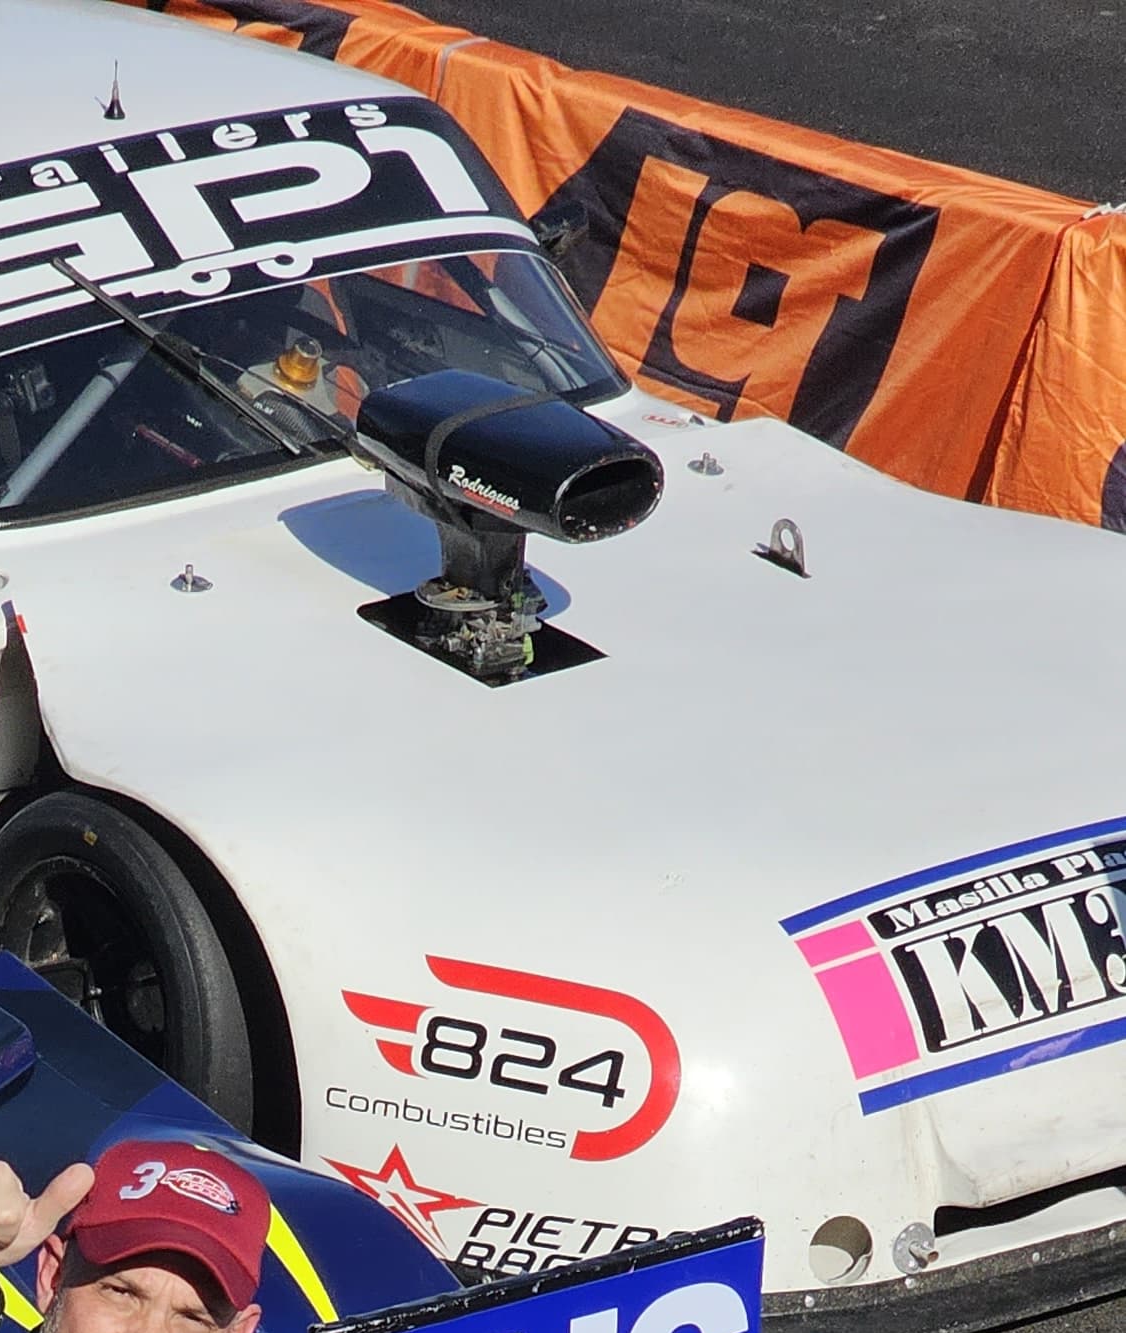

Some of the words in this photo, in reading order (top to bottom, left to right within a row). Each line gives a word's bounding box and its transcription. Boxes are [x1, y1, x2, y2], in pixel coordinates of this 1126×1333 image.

[883, 871, 1050, 933] Masilla
[419, 1016, 626, 1109] 824
[325, 1086, 567, 1151] Combustibles
[119, 1161, 166, 1200] 3
[469, 1207, 685, 1255] PIETR
